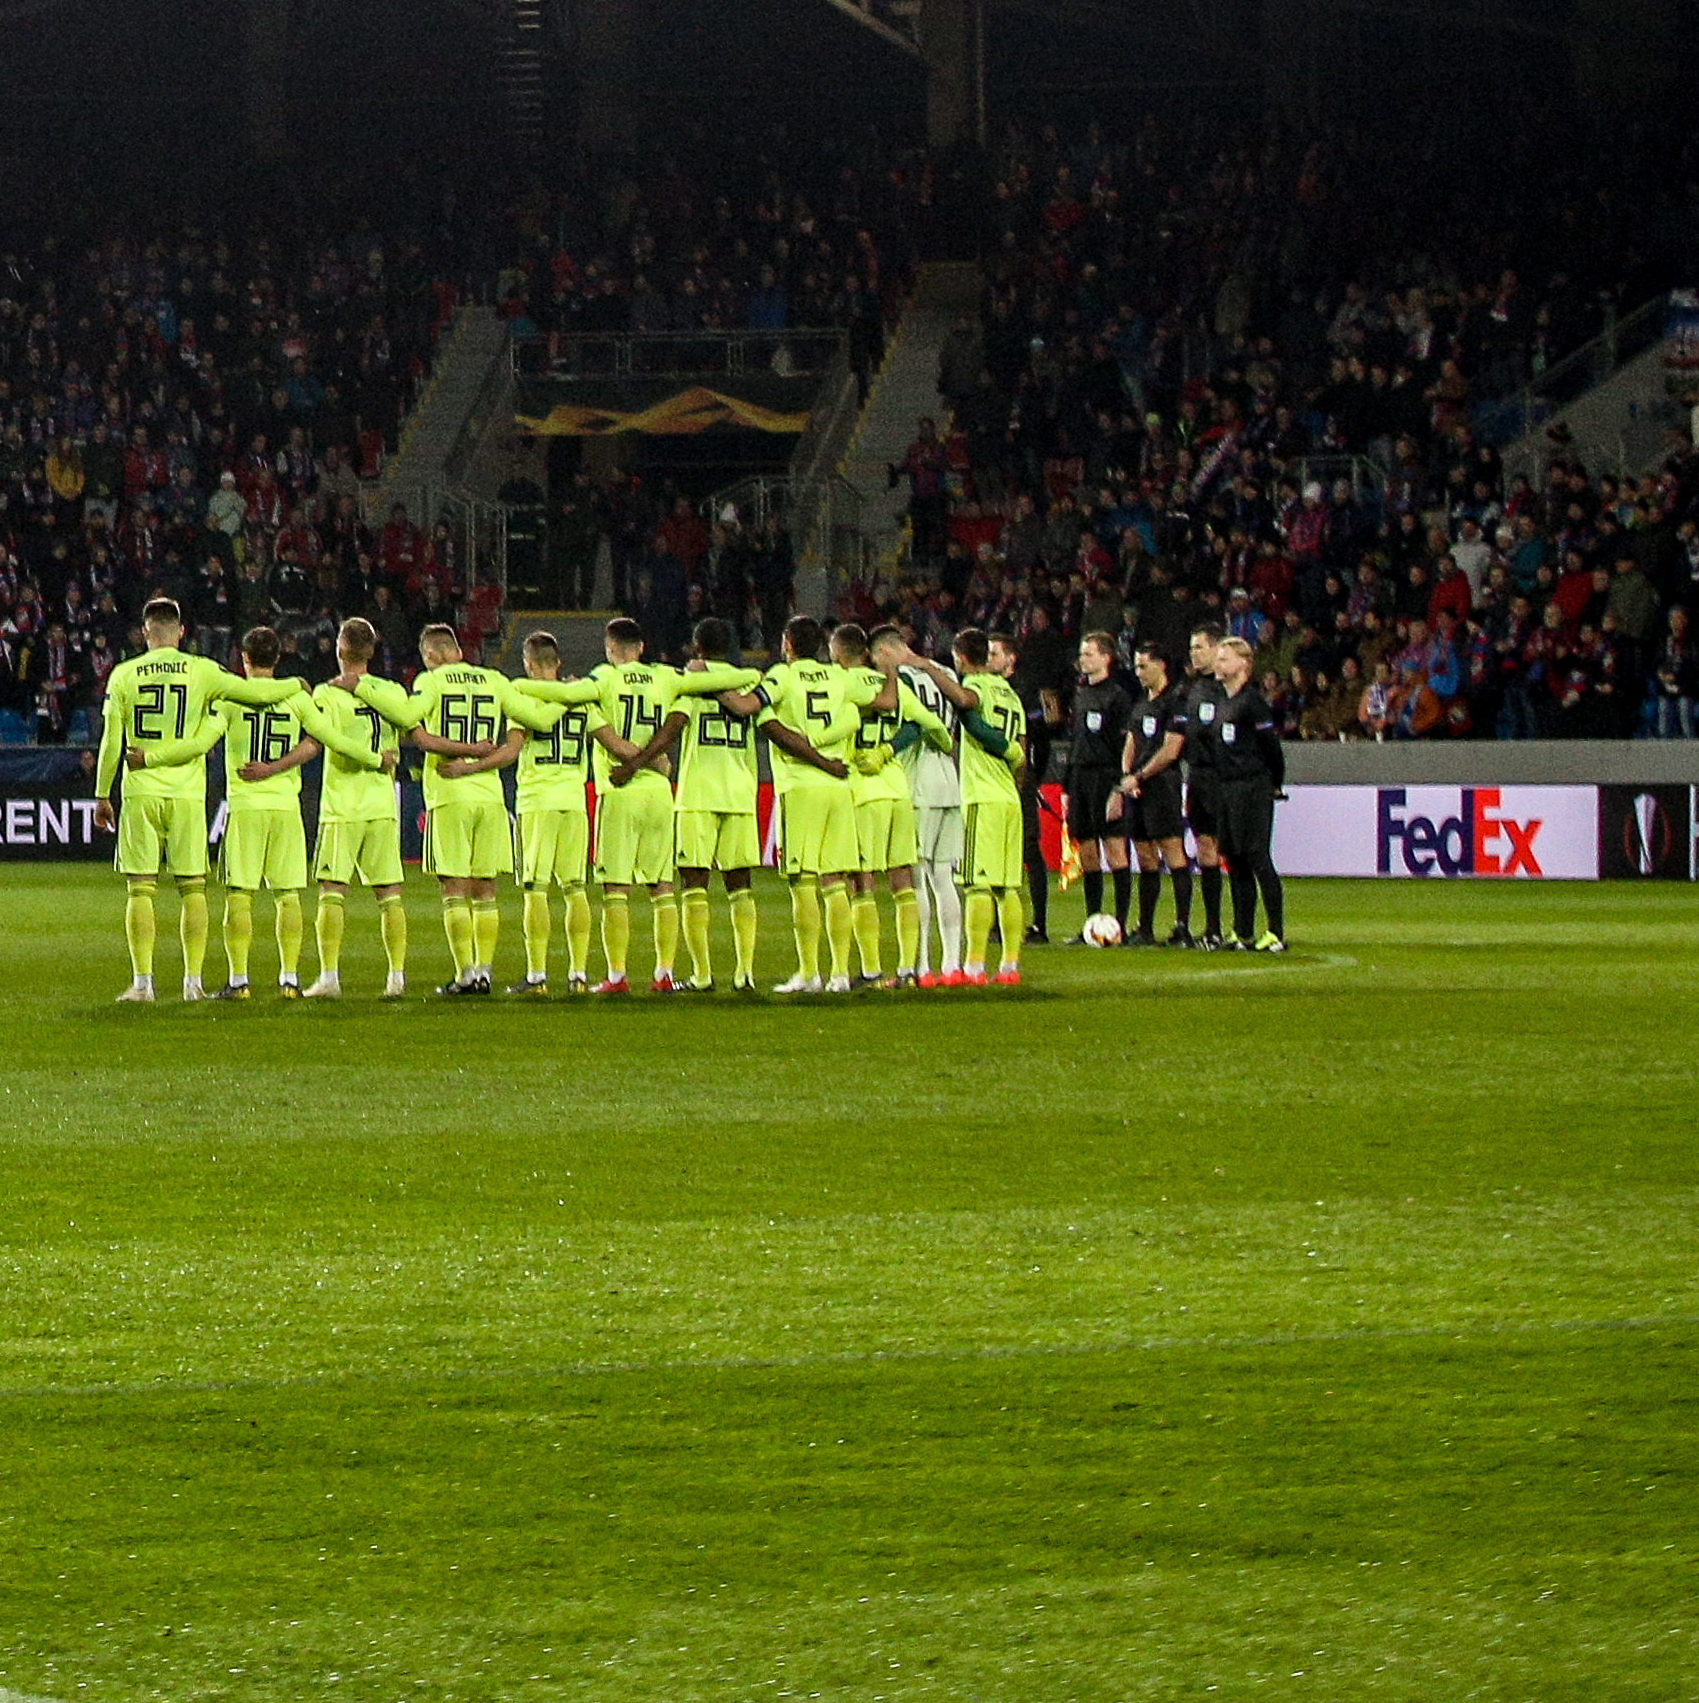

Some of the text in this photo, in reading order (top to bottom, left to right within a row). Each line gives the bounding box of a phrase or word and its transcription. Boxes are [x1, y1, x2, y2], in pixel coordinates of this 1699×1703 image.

[134, 684, 187, 739] 21
[441, 694, 495, 745] 66
[619, 694, 662, 742] 14
[805, 691, 832, 731] 5
[243, 712, 291, 763] 16
[1377, 788, 1543, 877] FedEx
